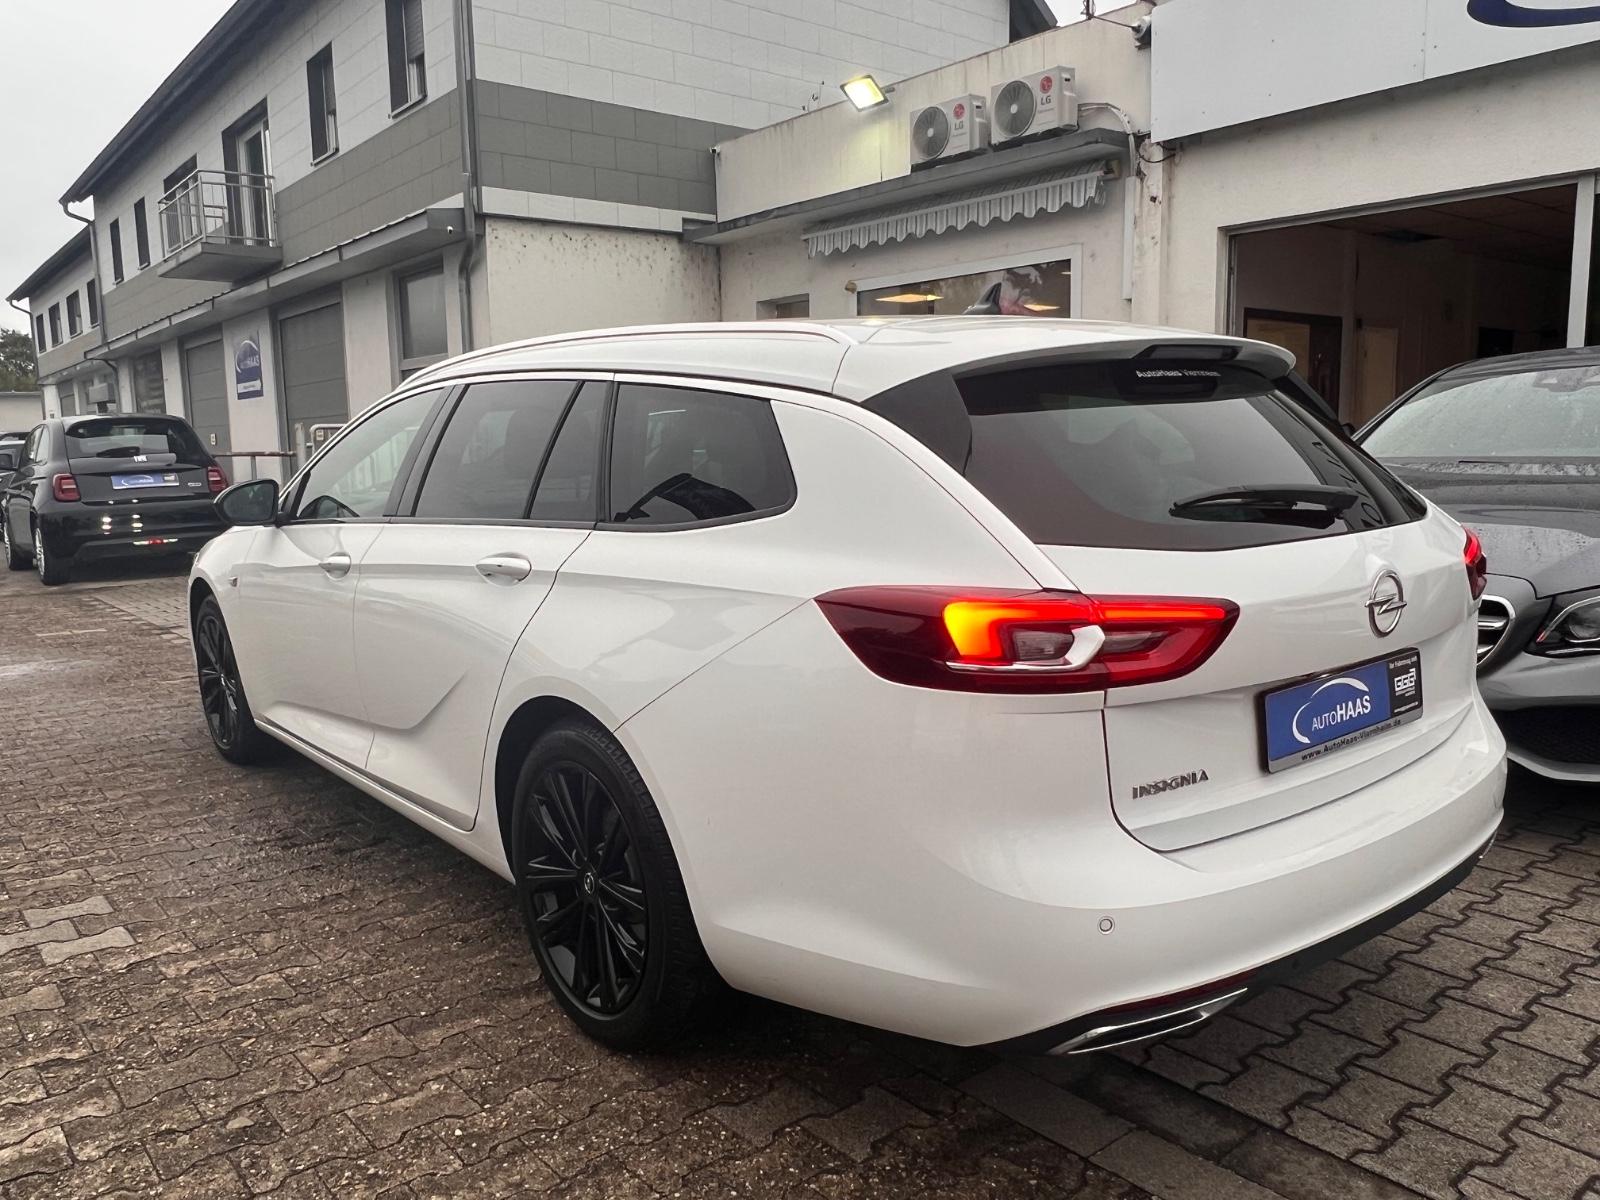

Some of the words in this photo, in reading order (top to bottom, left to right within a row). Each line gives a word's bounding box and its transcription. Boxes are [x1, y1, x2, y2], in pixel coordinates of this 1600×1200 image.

[1040, 95, 1052, 105] LG
[954, 121, 964, 131] LG
[1132, 768, 1209, 799] INSIGNIA
